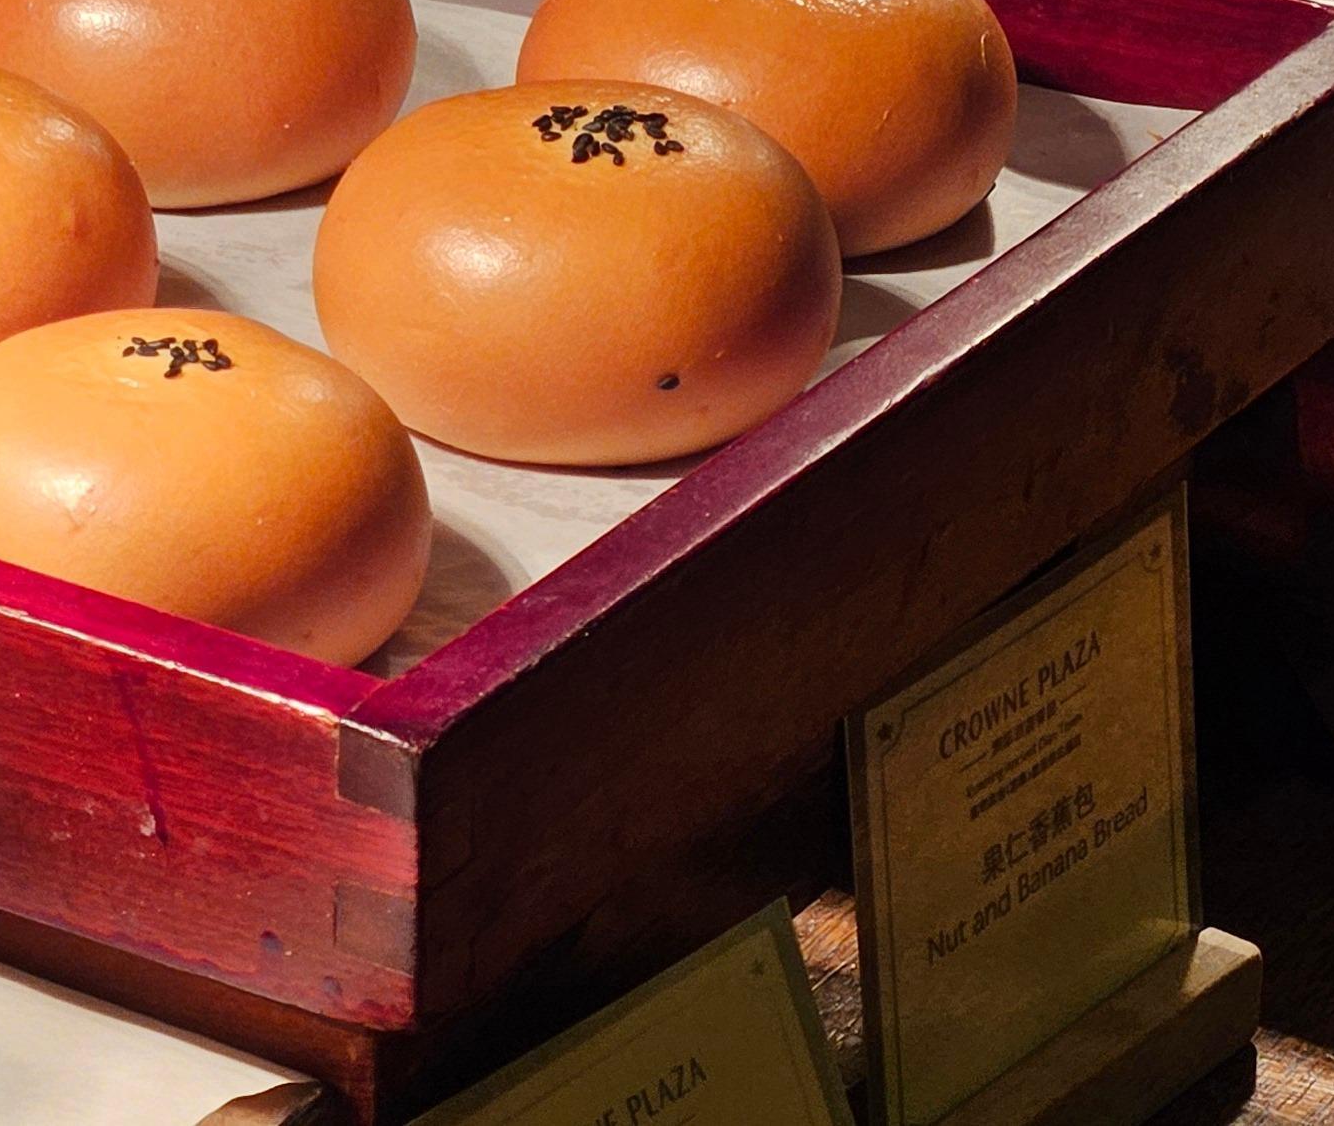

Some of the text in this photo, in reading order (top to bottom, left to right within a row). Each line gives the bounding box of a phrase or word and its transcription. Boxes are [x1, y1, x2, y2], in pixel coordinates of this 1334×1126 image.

[939, 677, 1030, 760] CROWNE
[1038, 630, 1101, 696] PLAZA
[926, 786, 1148, 965] Nut and Banana Bread
[980, 782, 1096, 885] 果仁香蕉包
[626, 1056, 708, 1126] PLAZA
